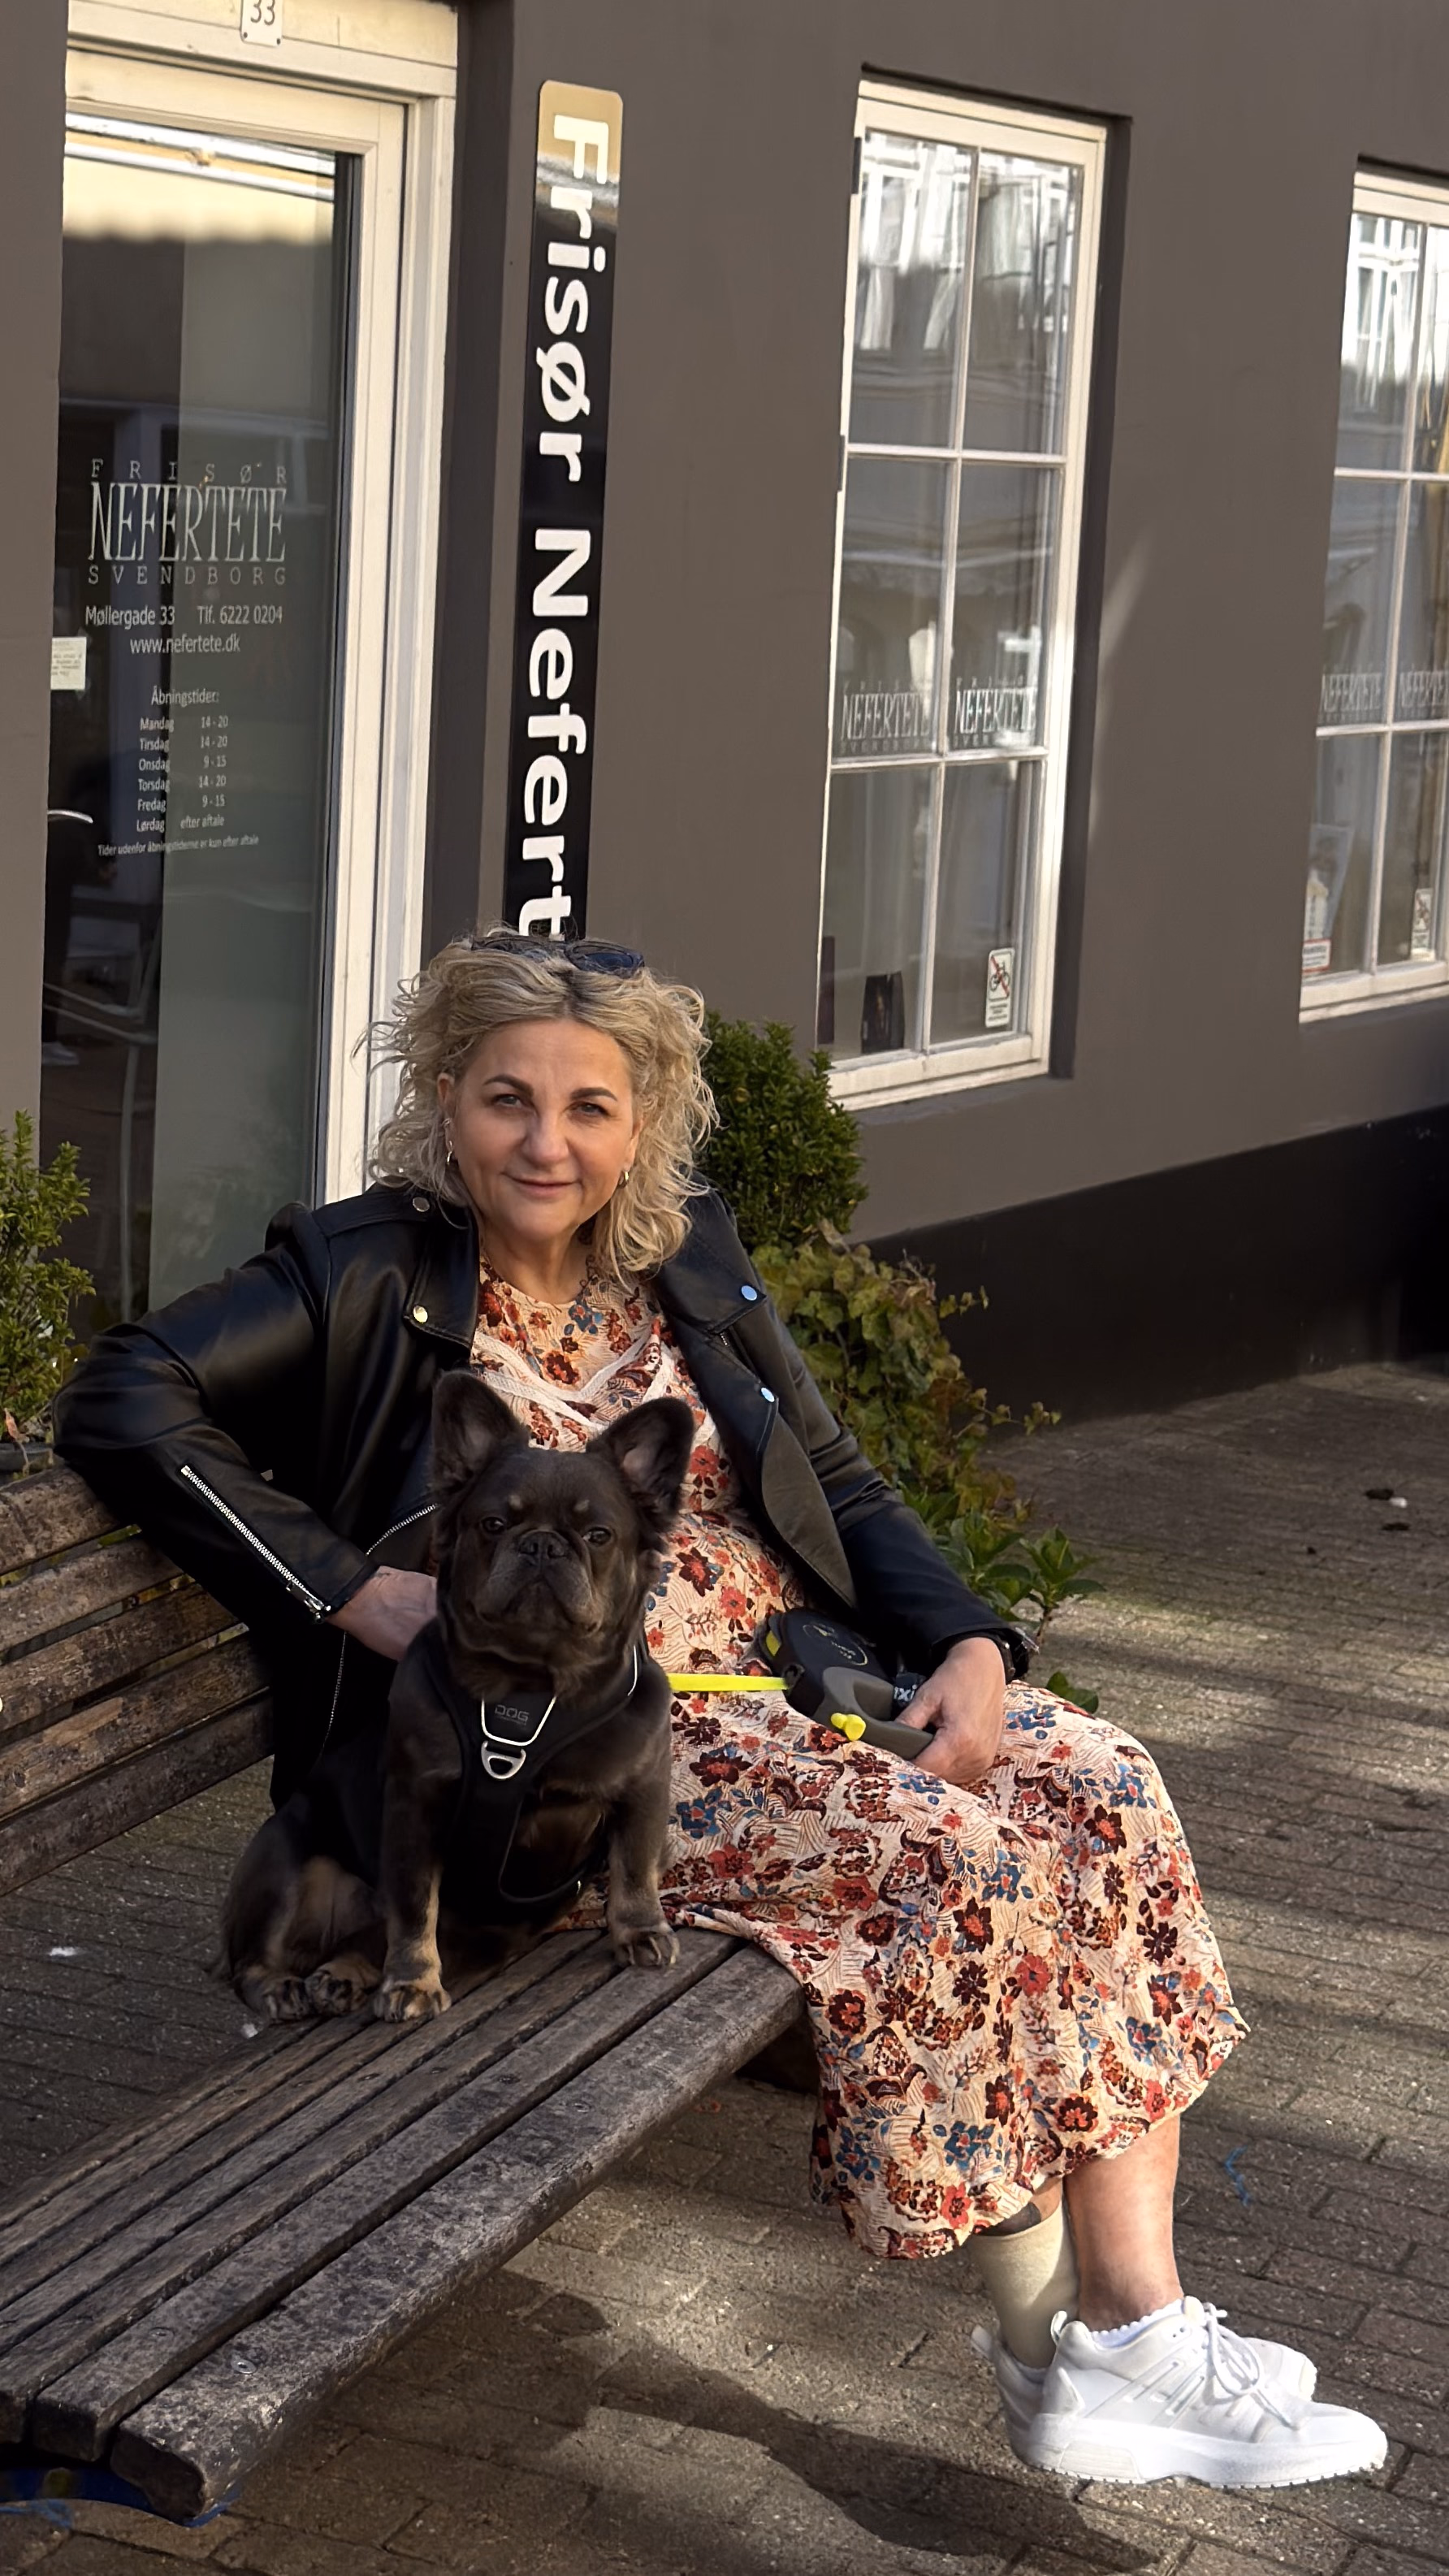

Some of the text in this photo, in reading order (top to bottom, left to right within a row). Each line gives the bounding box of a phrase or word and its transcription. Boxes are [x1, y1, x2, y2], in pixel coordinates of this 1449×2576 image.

[250, 0, 275, 25] 33
[536, 115, 609, 483] Frisør
[88, 482, 287, 561] NEFERTETE
[88, 565, 286, 585] SVENDBORG
[85, 605, 156, 630] Møllergade
[158, 606, 175, 625] 33
[219, 605, 250, 625] 6222
[253, 605, 283, 625] 0204
[130, 633, 241, 653] www.nefertete.dk
[151, 686, 219, 708] Åbningstider:
[140, 717, 175, 733] Mandag
[201, 716, 211, 729] 14
[218, 715, 229, 729] 20
[140, 737, 170, 752] Tirsdag
[201, 735, 210, 749] 14
[217, 735, 228, 747] 20
[138, 756, 171, 772] Onsdag
[204, 755, 210, 768] 9
[216, 755, 227, 768] 15
[138, 777, 171, 793] Torsdag
[199, 775, 209, 789] 14
[215, 775, 227, 787] 20
[137, 798, 167, 813] Fredag
[202, 795, 208, 807] 9
[215, 794, 226, 807] 15
[136, 817, 165, 833] Lørdag
[495, 1704, 530, 1722] DOG
